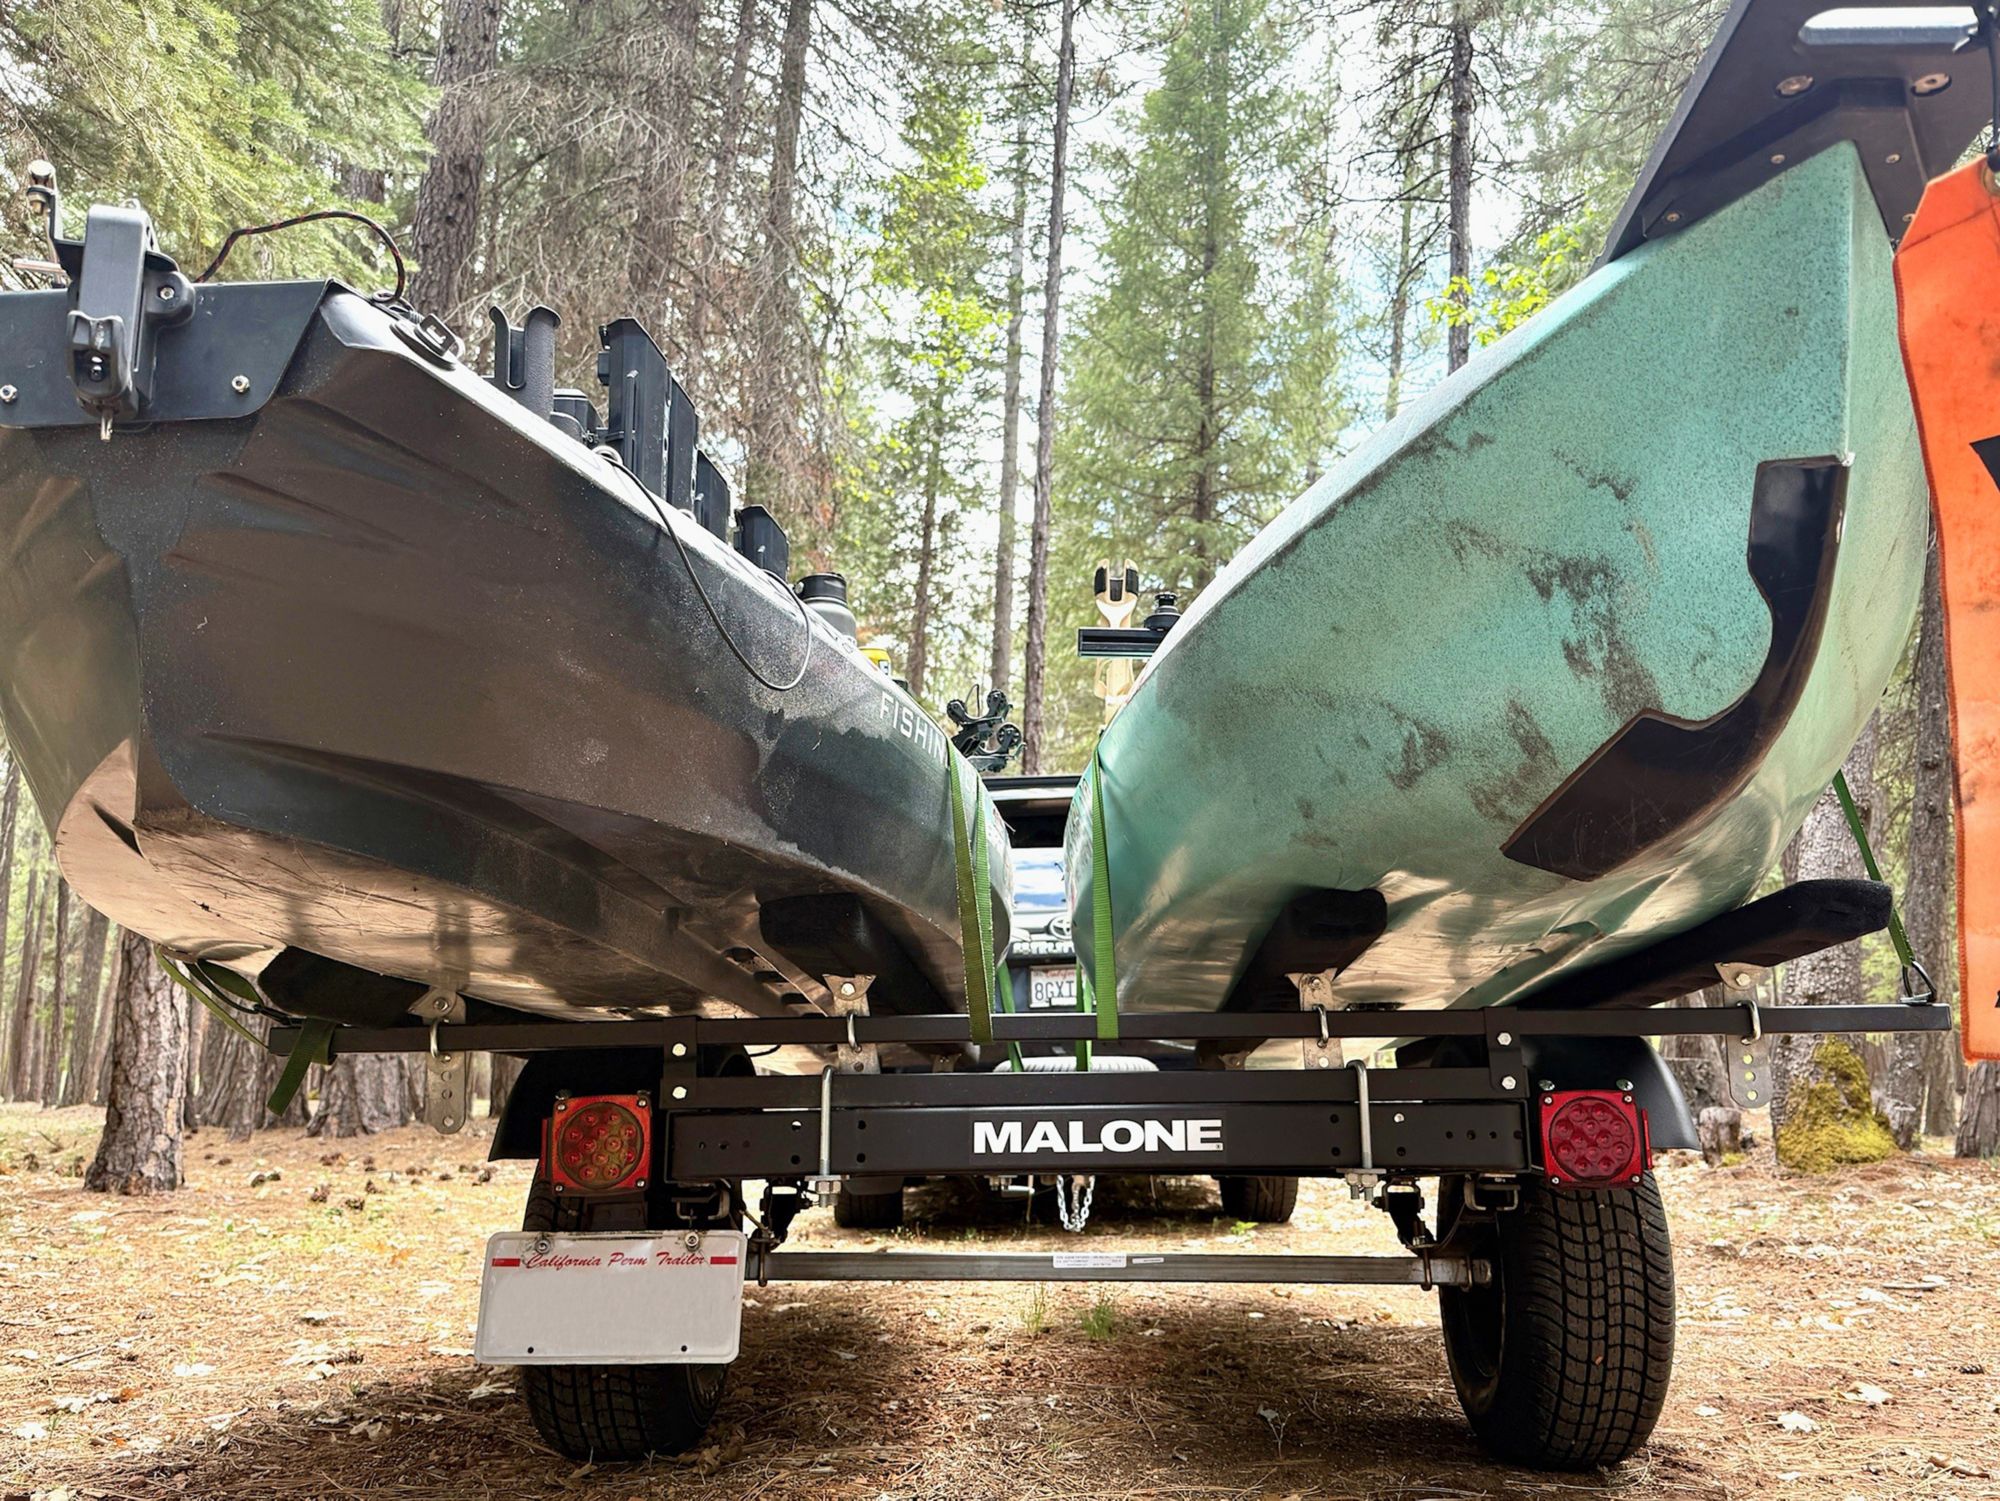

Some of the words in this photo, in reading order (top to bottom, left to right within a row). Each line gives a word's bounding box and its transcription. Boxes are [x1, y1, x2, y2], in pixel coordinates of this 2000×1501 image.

[880, 691, 948, 769] FISHIN
[974, 1120, 1223, 1154] MALONE
[525, 1253, 602, 1270] California
[607, 1252, 648, 1267] Perm
[655, 1251, 705, 1266] Trailer
